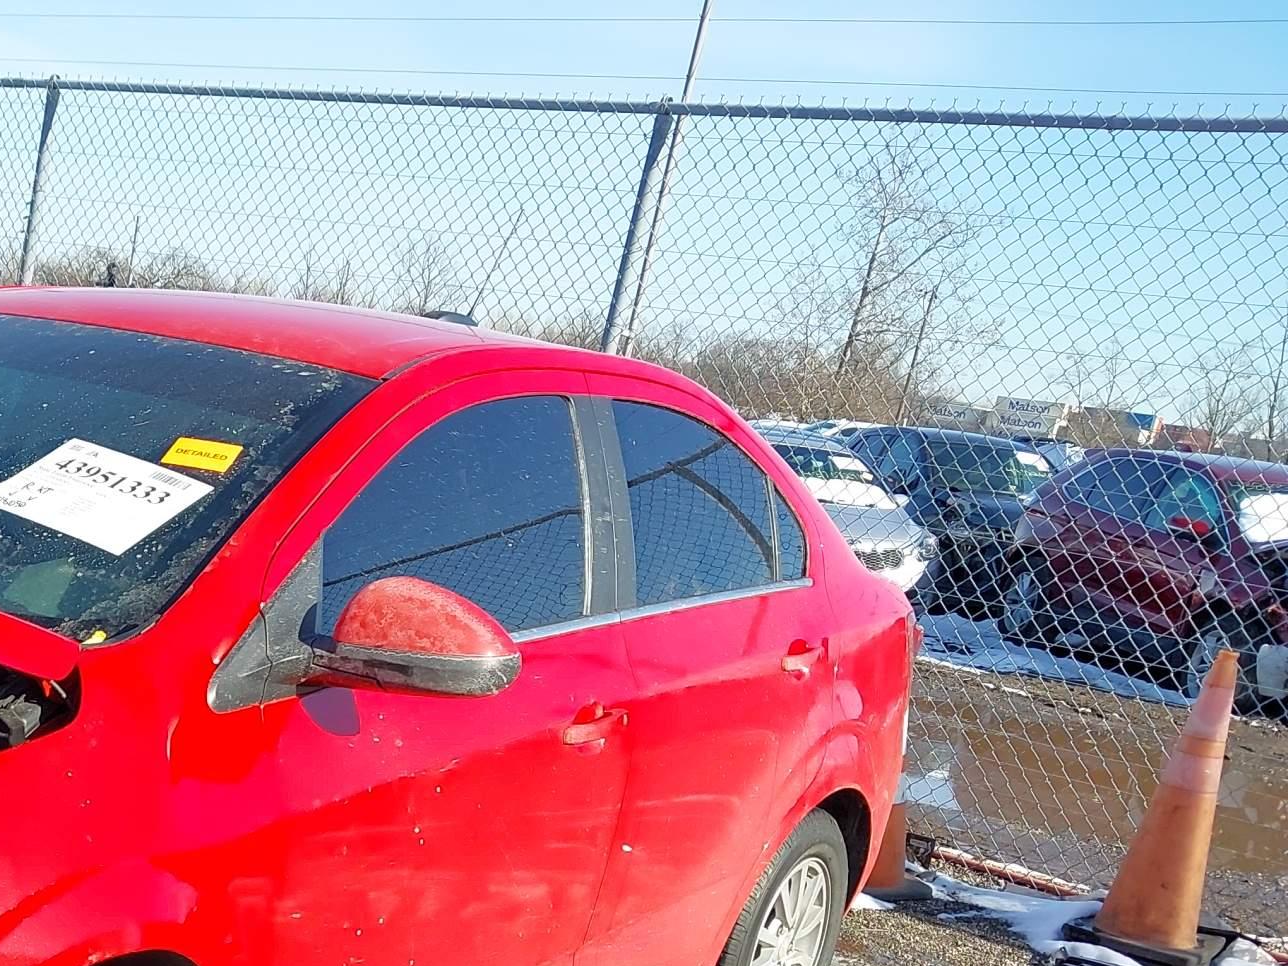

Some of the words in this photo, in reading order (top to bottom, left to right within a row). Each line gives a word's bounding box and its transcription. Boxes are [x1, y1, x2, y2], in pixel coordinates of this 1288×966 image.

[1008, 399, 1050, 414] Matson
[175, 447, 228, 461] DETAILED
[55, 458, 171, 505] 43951333
